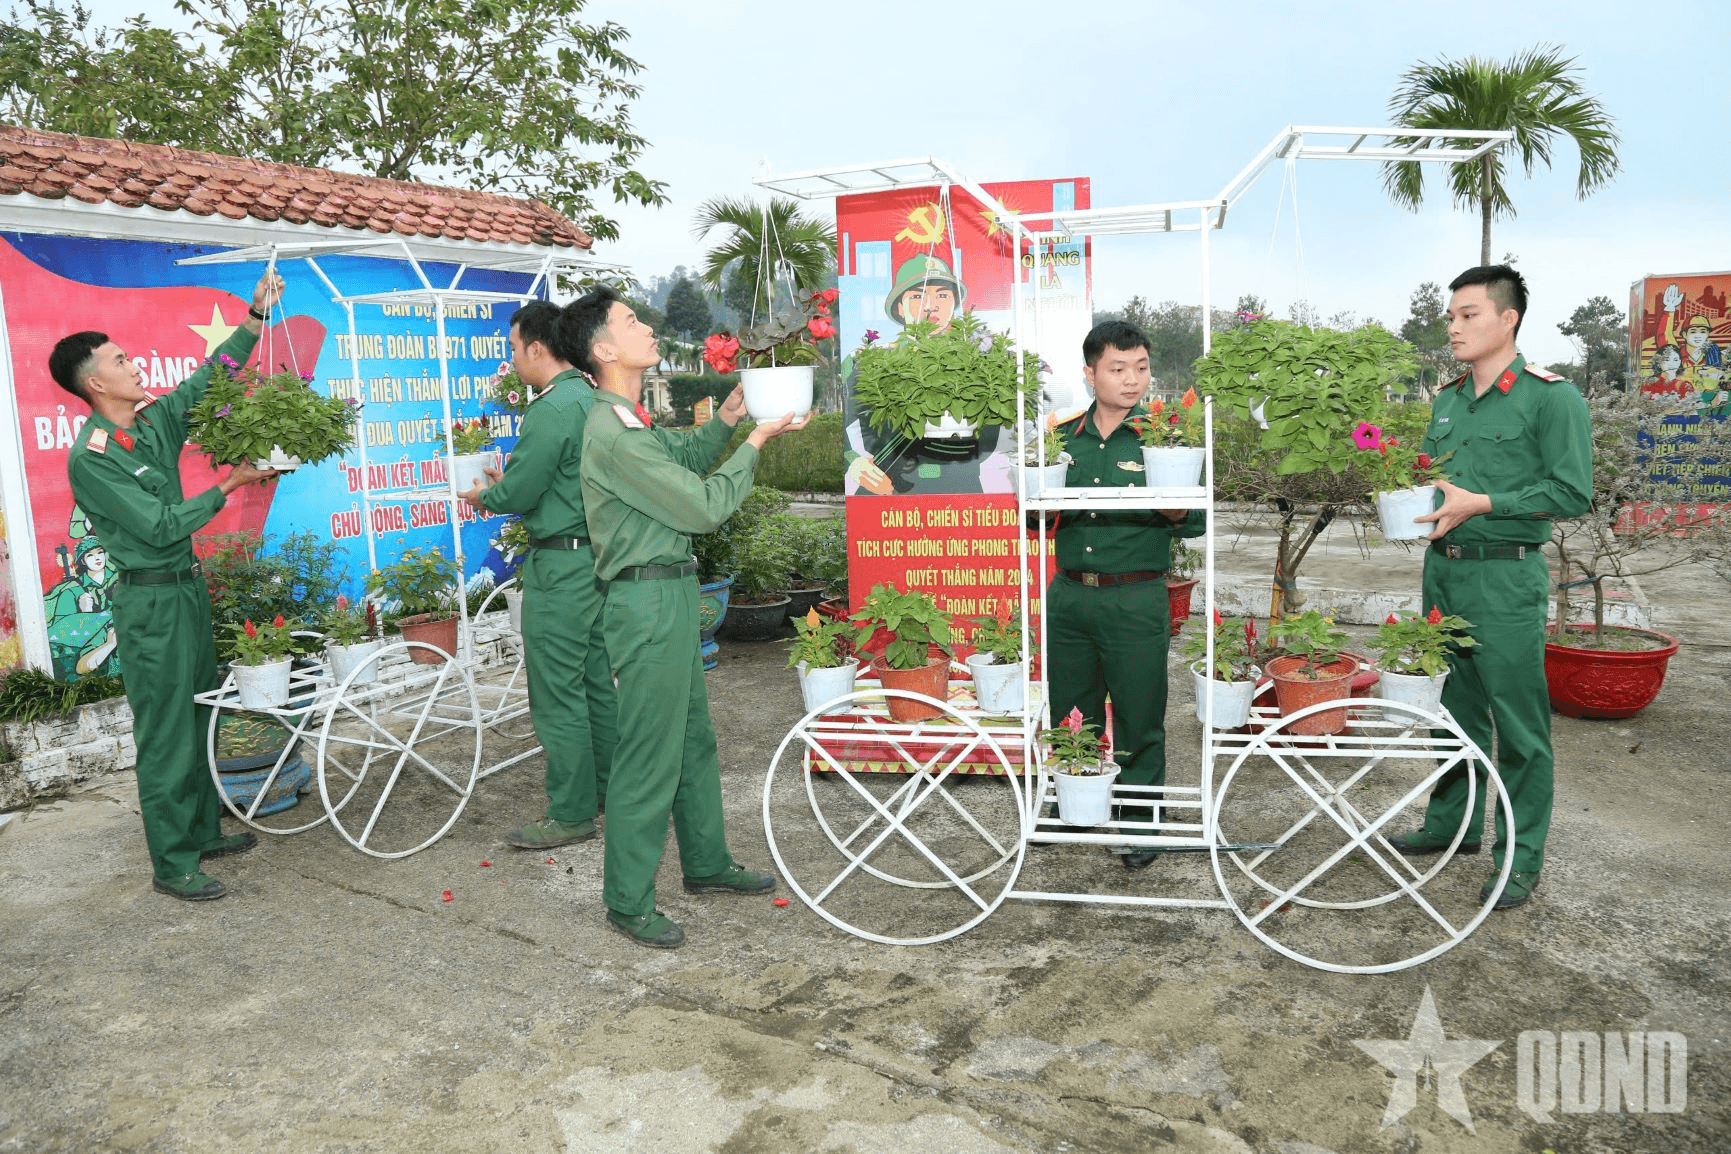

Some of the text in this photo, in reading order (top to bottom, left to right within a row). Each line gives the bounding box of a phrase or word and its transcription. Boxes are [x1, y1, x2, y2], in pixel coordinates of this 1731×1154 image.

[335, 328, 507, 361] TRUNG ĐOÀN B971 QUYẾT
[368, 372, 403, 408] HIỆN
[405, 368, 446, 402] THẮN
[451, 374, 471, 404] LỢI
[366, 421, 395, 447] ĐUA
[397, 411, 438, 448] QUYẾT
[390, 454, 418, 489] KẾT,
[330, 502, 361, 539] CHỦ
[367, 503, 408, 538] ỘNG,
[449, 499, 477, 527] ẠO,
[881, 502, 1020, 532] CÁN BỘ, CHIẾN SĨ TIỂU ĐO
[856, 536, 880, 558] TÍCH
[883, 538, 904, 561] CỰC
[907, 534, 944, 557] HƯỞNG
[946, 535, 969, 556] ỨNG
[971, 538, 1009, 557] PHONG
[905, 562, 1034, 588] QUYẾT THẮNG NĂM 204
